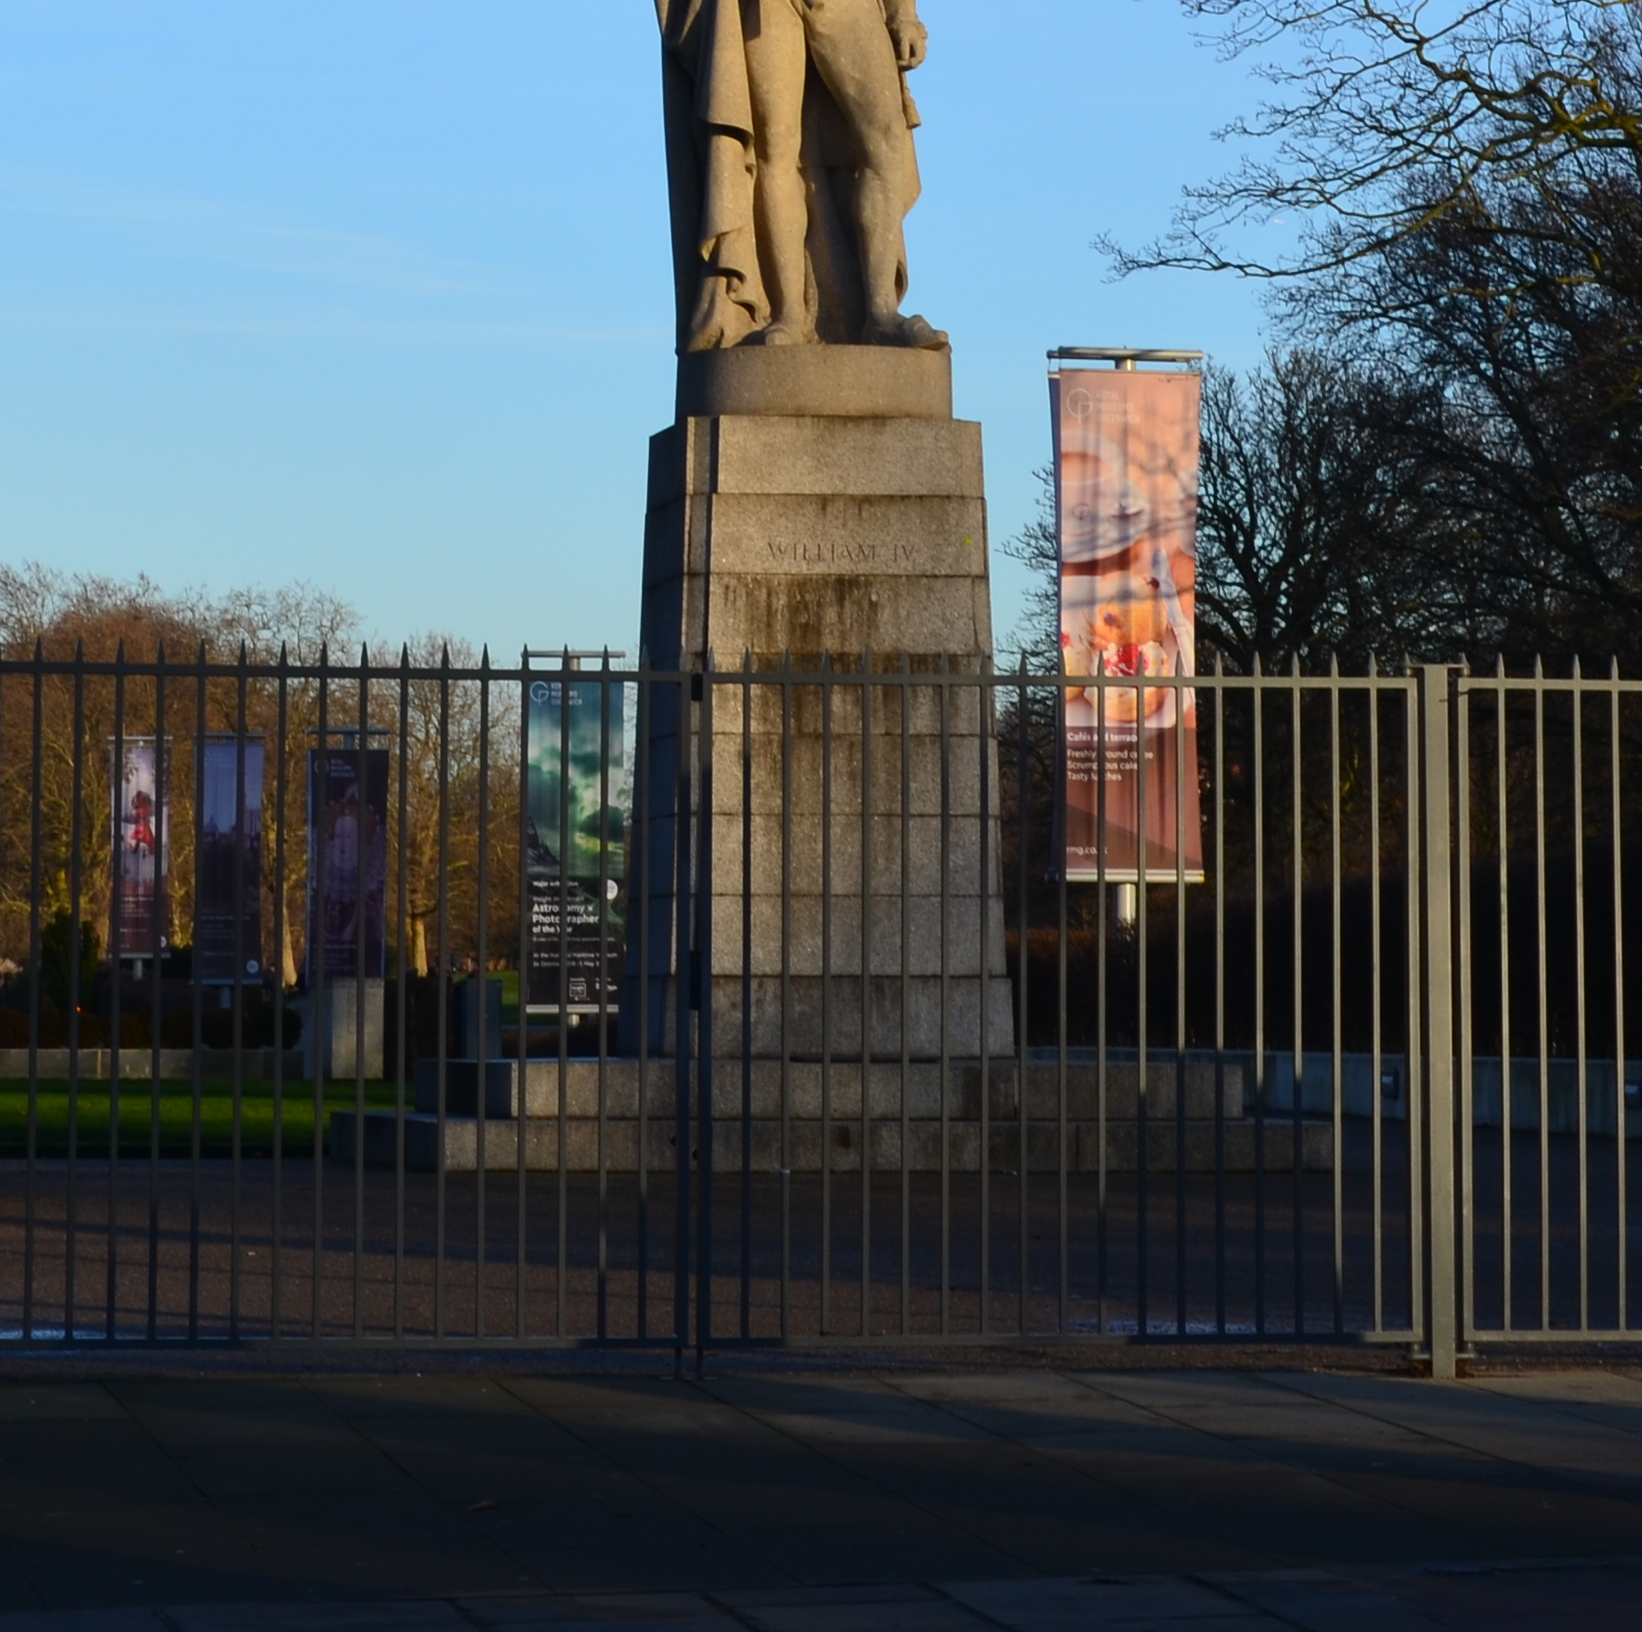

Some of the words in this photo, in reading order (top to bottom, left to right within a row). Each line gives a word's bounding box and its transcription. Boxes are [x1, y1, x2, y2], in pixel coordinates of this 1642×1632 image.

[768, 541, 878, 562] WILLIAM
[892, 543, 916, 563] IV
[1066, 748, 1097, 760] Freshly
[1066, 771, 1089, 783] Tasty
